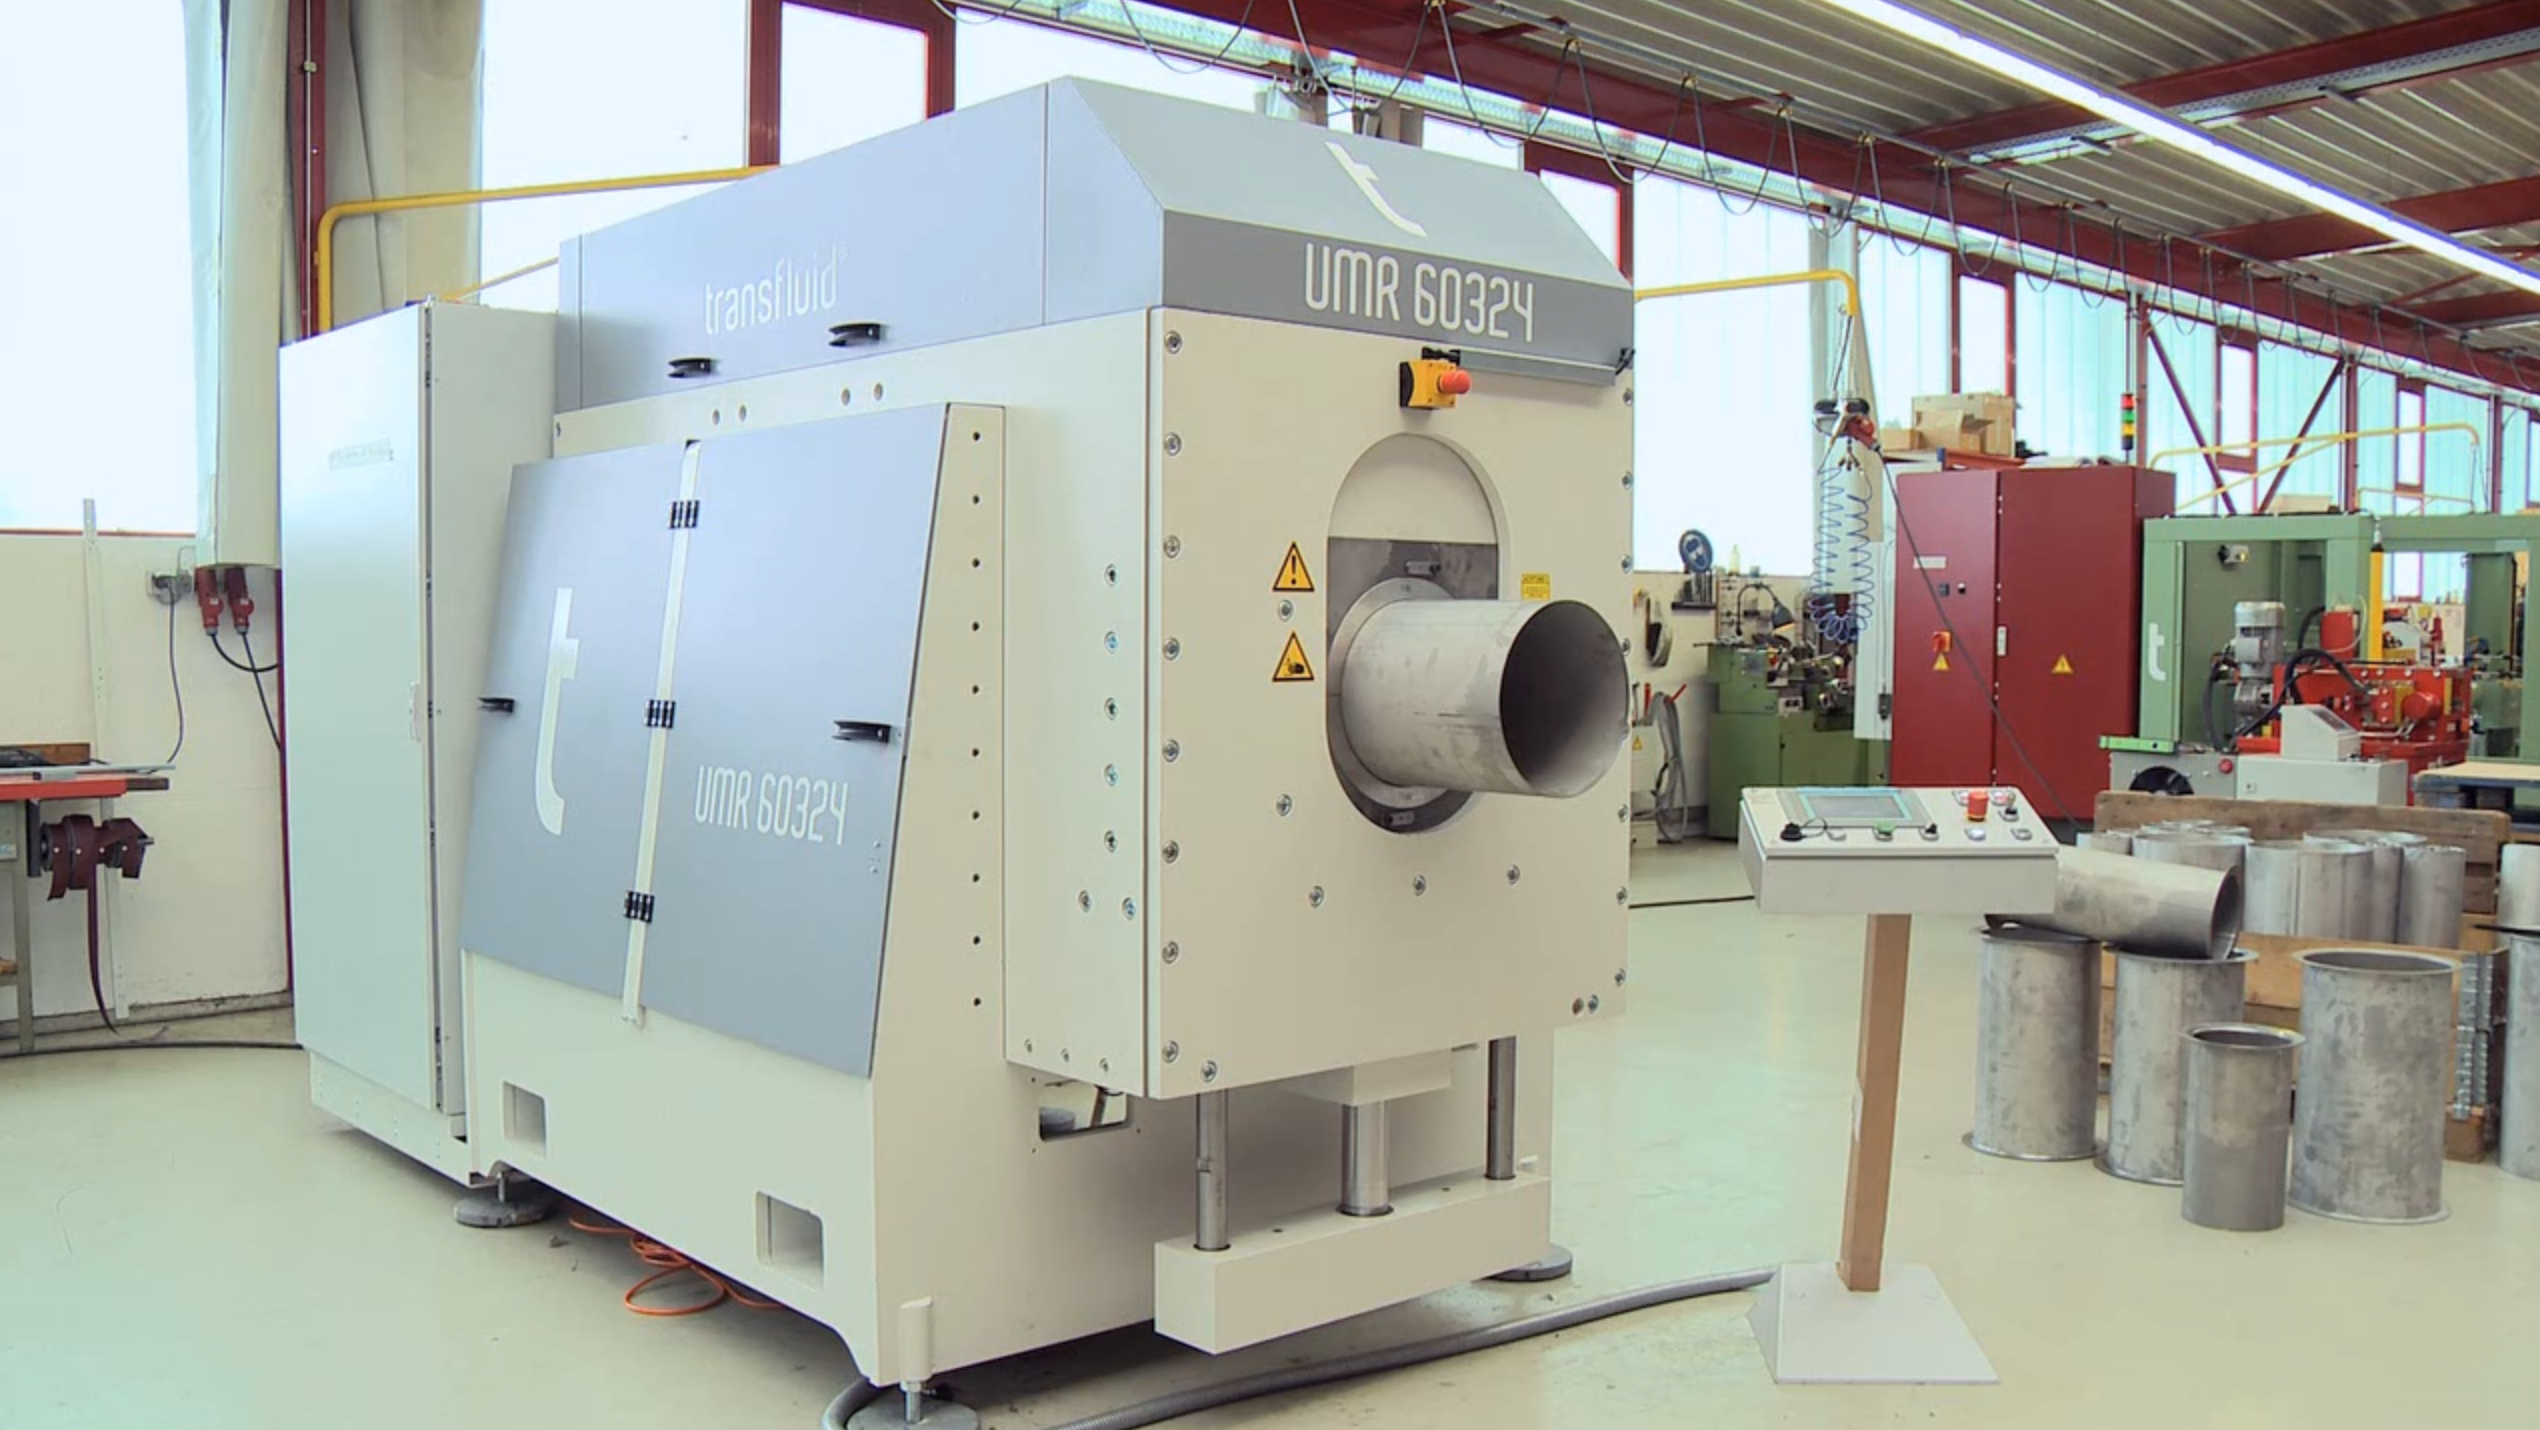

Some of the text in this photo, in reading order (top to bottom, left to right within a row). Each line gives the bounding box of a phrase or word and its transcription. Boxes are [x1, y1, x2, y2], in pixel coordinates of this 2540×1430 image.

[1304, 243, 1534, 343] UMR 60324
[2148, 623, 2167, 681] t
[535, 587, 579, 835] t
[694, 765, 848, 846] UMR 60324
